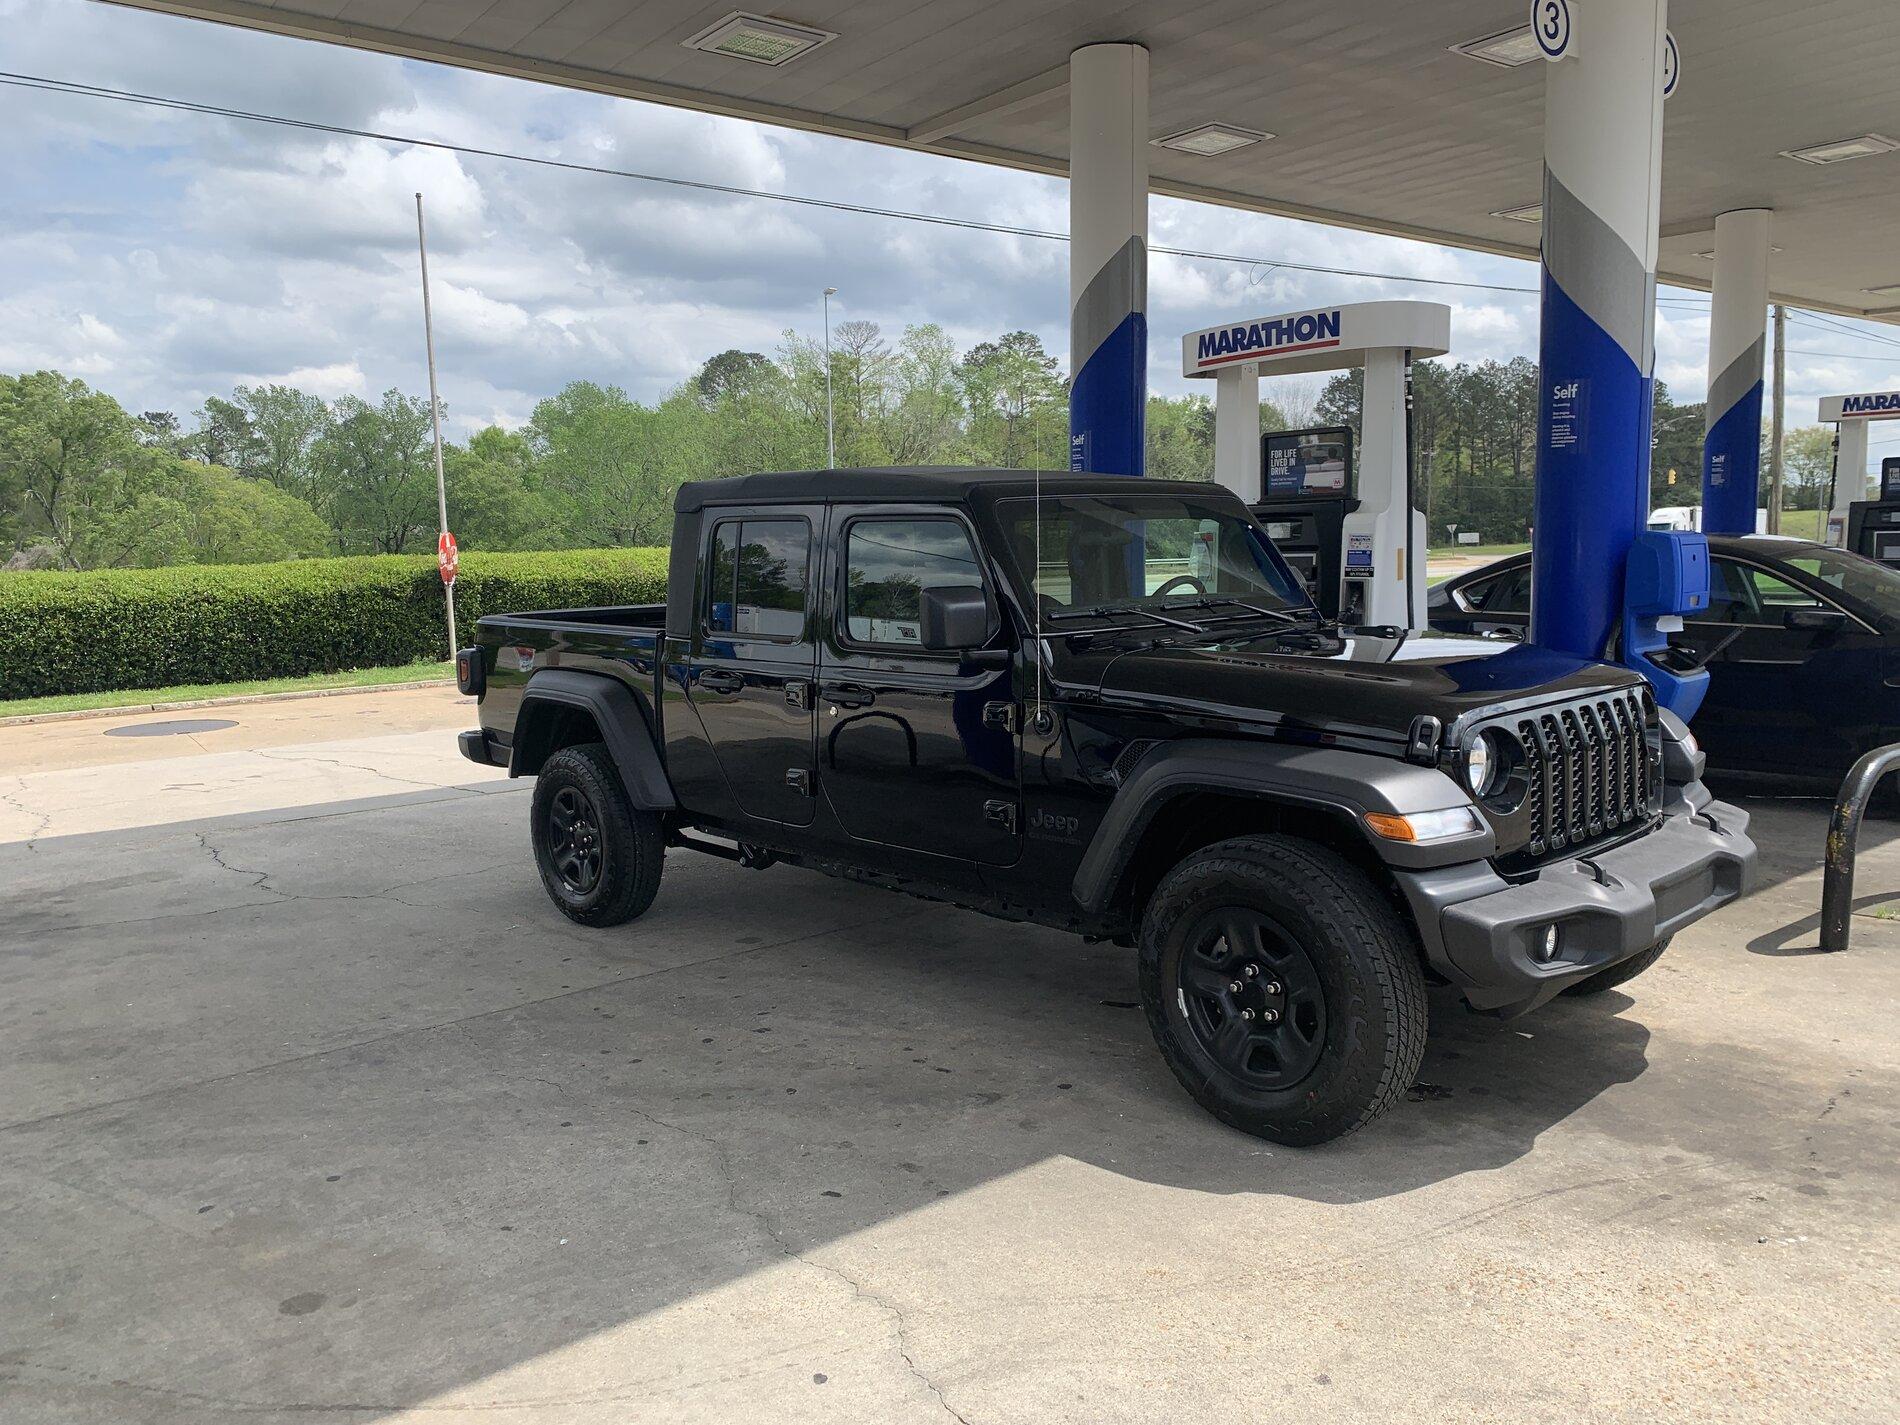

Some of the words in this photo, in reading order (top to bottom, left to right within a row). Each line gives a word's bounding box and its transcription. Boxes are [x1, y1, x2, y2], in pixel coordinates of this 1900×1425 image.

[1543, 1, 1559, 39] 3
[1198, 310, 1341, 360] MARATHON
[1553, 384, 1579, 399] Self
[1072, 433, 1085, 446] Self
[1270, 449, 1283, 459] FOR
[1283, 448, 1297, 458] LIFE
[1270, 458, 1288, 467] LIVED
[1288, 457, 1296, 467] IN
[1270, 466, 1290, 476] DRIVE.
[1030, 808, 1080, 837] Jeep
